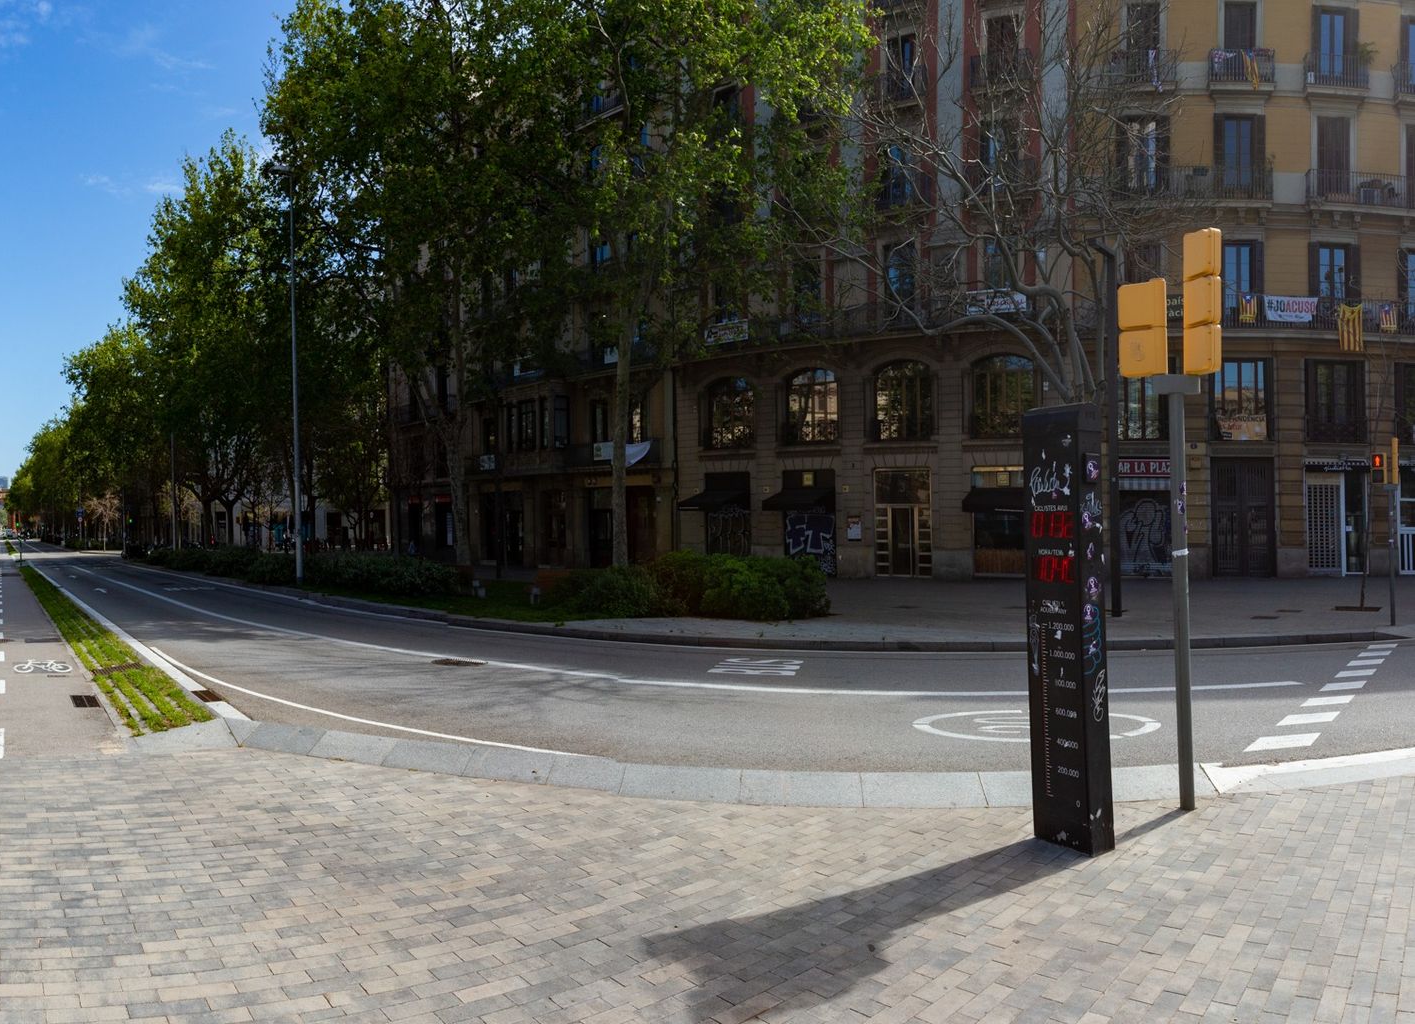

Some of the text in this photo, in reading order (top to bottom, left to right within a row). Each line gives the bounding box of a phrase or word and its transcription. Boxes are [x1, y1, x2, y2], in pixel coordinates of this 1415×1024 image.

[1267, 298, 1315, 314] #JOACUSO
[1118, 461, 1171, 473] AR LA PLAZ
[1048, 621, 1075, 632] 1.200.000
[1049, 650, 1076, 660] 1.000.000
[707, 658, 804, 676] BUS
[1057, 765, 1080, 778] 200.000
[1075, 800, 1081, 808] 0
